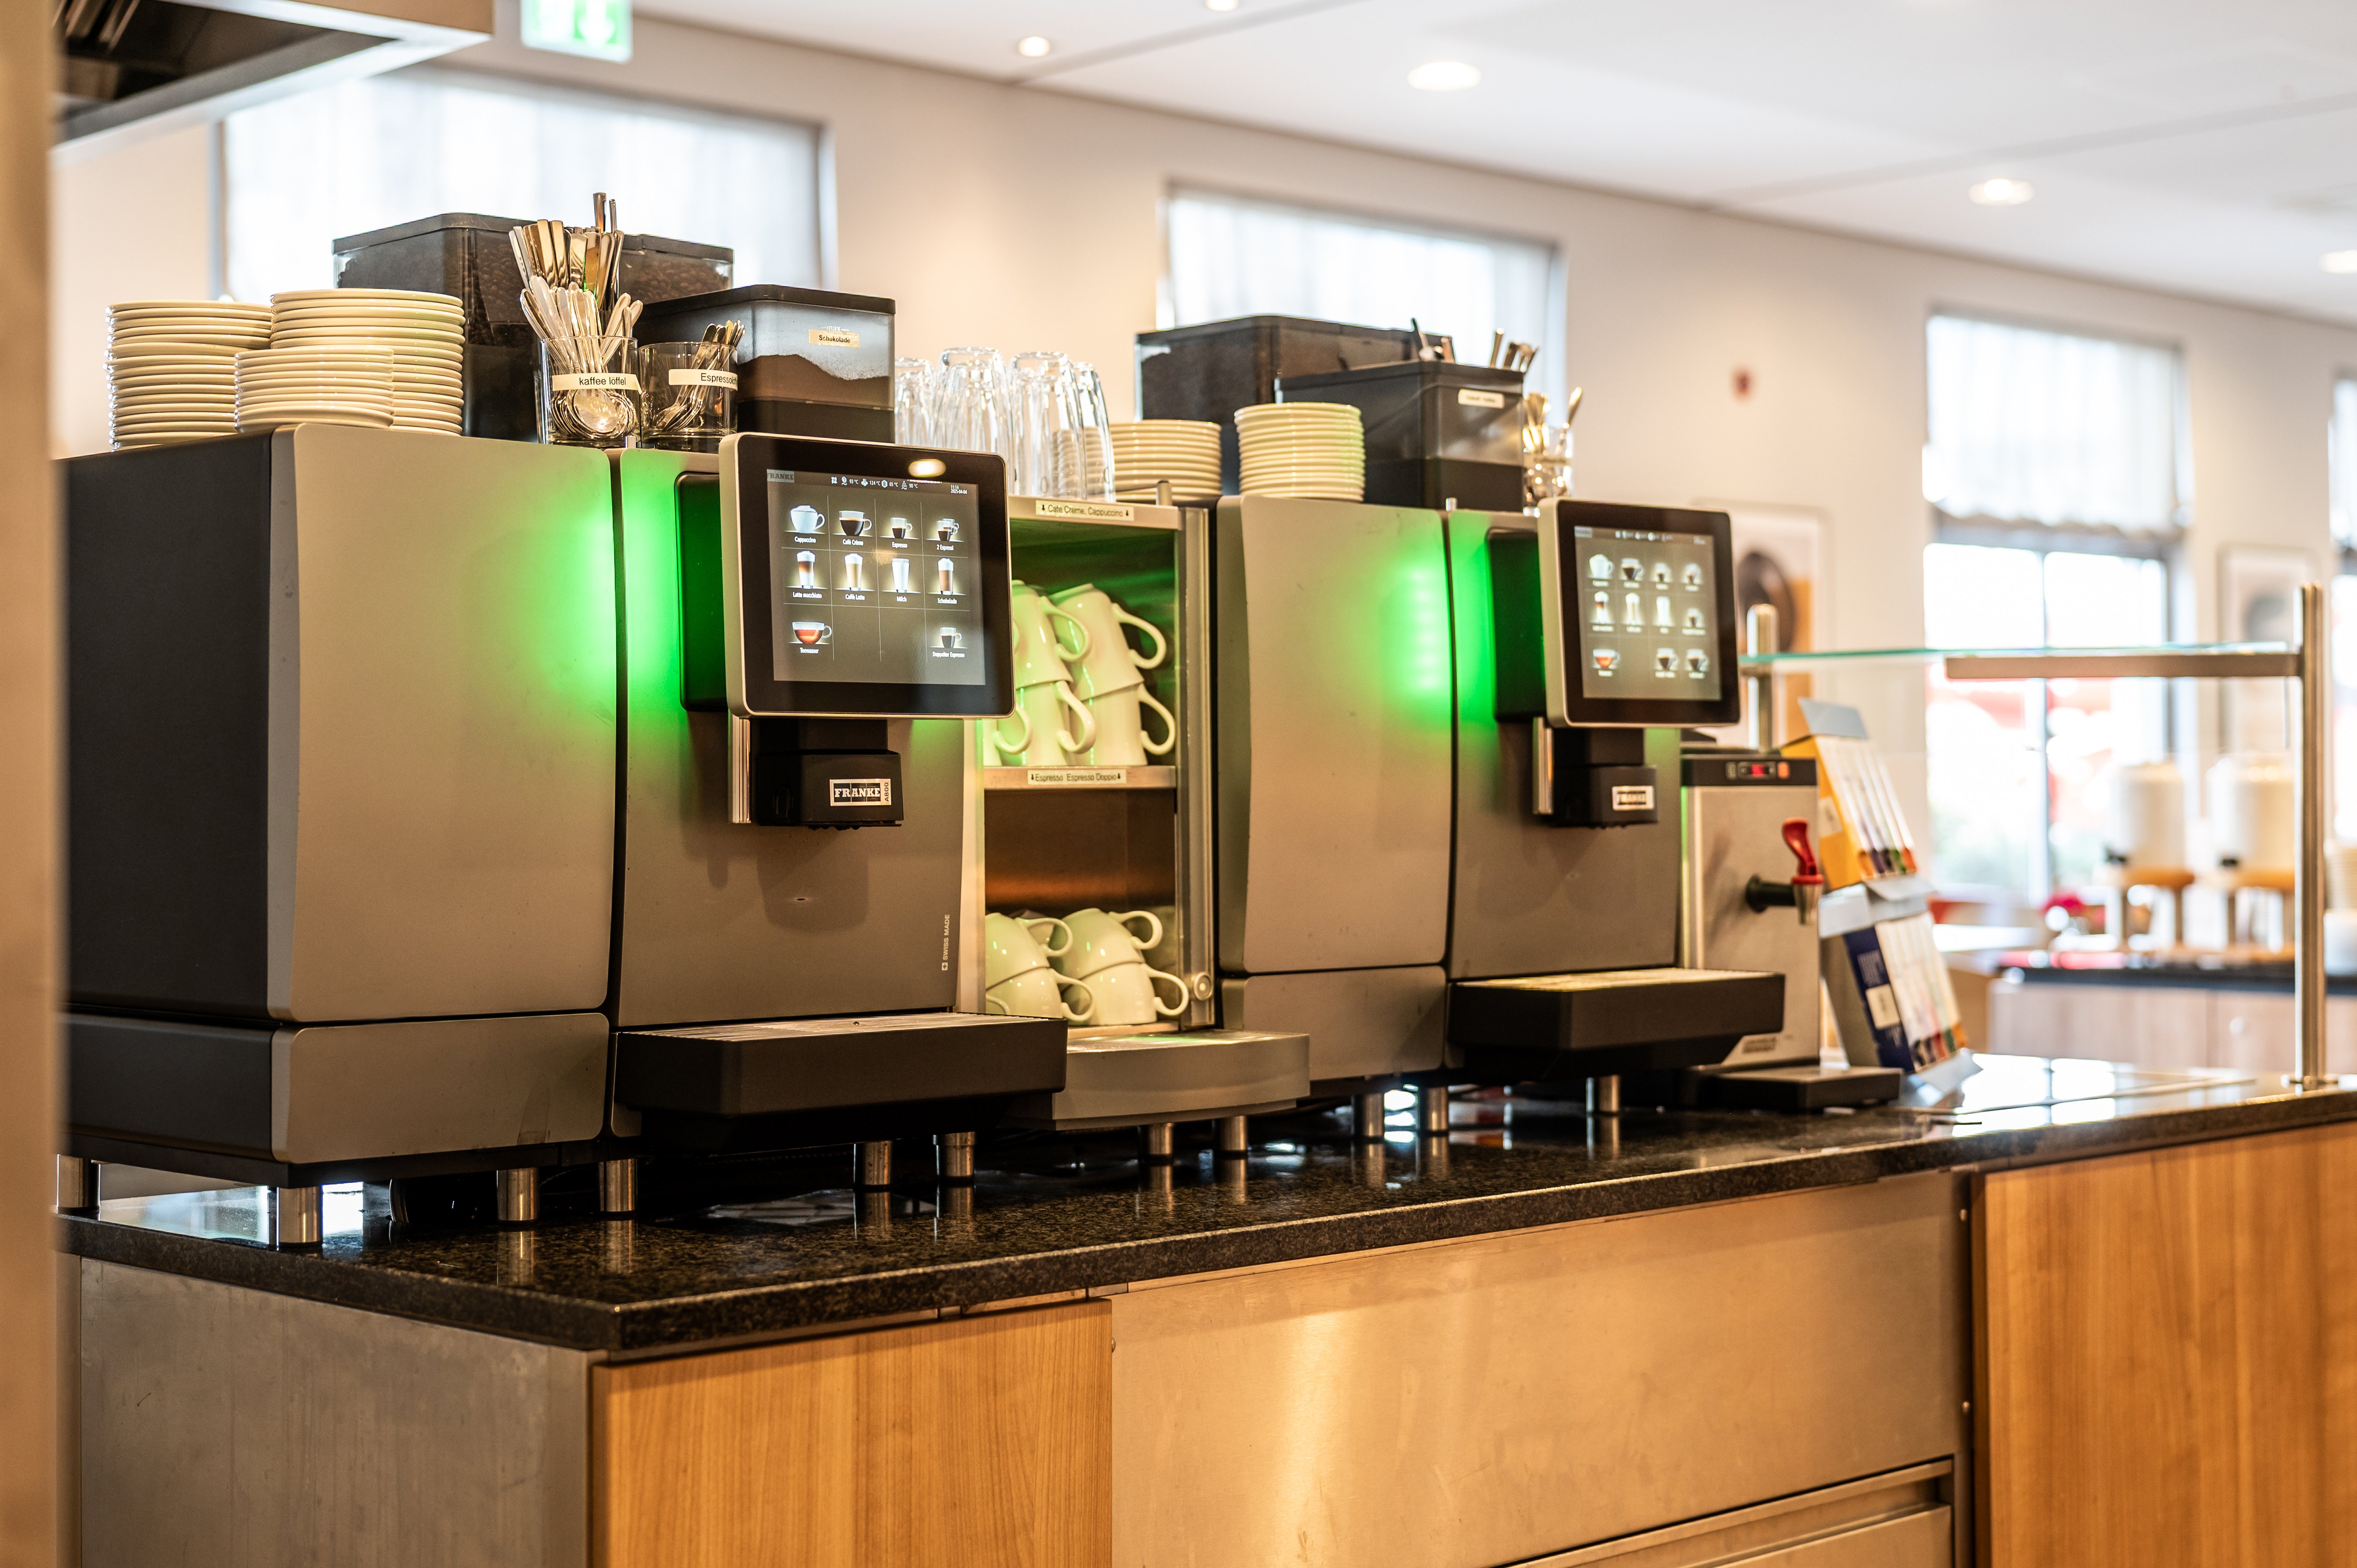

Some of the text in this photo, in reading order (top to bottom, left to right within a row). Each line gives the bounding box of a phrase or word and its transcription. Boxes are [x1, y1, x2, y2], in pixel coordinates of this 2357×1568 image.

[818, 335, 850, 343] Schokolade
[579, 377, 626, 385] kaffee löffel
[1088, 507, 1123, 517] Cappuccino
[1067, 773, 1094, 782] Espresso
[1096, 773, 1116, 782] Doppio
[834, 788, 880, 797] FRANKE
